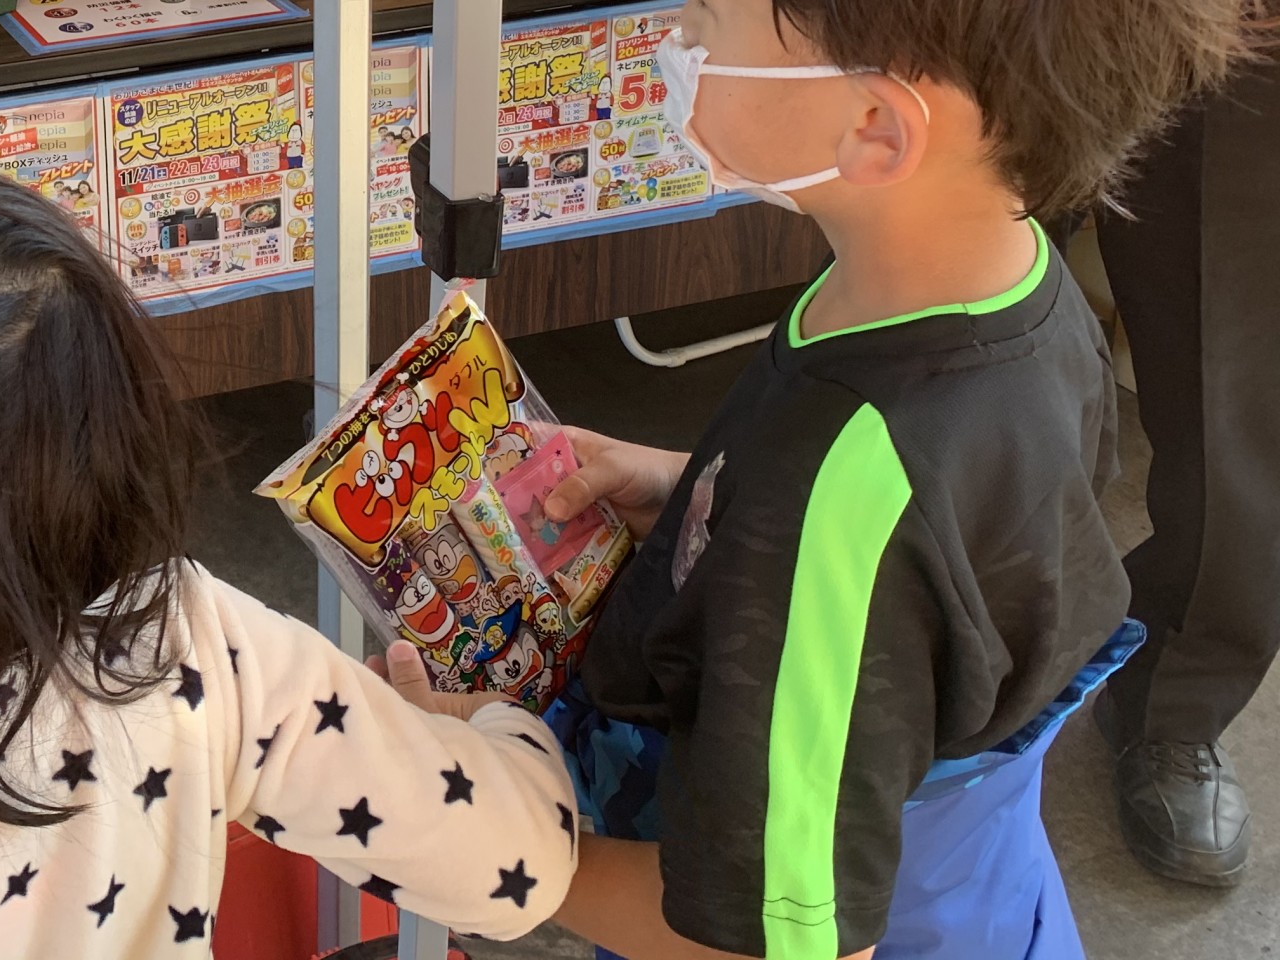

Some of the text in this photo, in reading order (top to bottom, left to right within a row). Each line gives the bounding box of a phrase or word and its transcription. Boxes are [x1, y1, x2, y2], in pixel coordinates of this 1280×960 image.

[119, 103, 141, 113] スタッフ
[146, 81, 269, 120] リニューアルオープン!!
[29, 108, 66, 124] nepia
[119, 100, 271, 165] 大感謝祭
[38, 160, 95, 185] プレゼント
[151, 191, 172, 202] 給油で
[206, 173, 284, 207] 大抽選会
[148, 208, 176, 220] 当たる!!
[255, 255, 281, 267] 割引券
[409, 331, 459, 375] ひとりじめ
[447, 354, 489, 392] ダブル
[321, 411, 371, 463] 7つの海を
[408, 430, 494, 532] スモール
[595, 564, 613, 588] お宝
